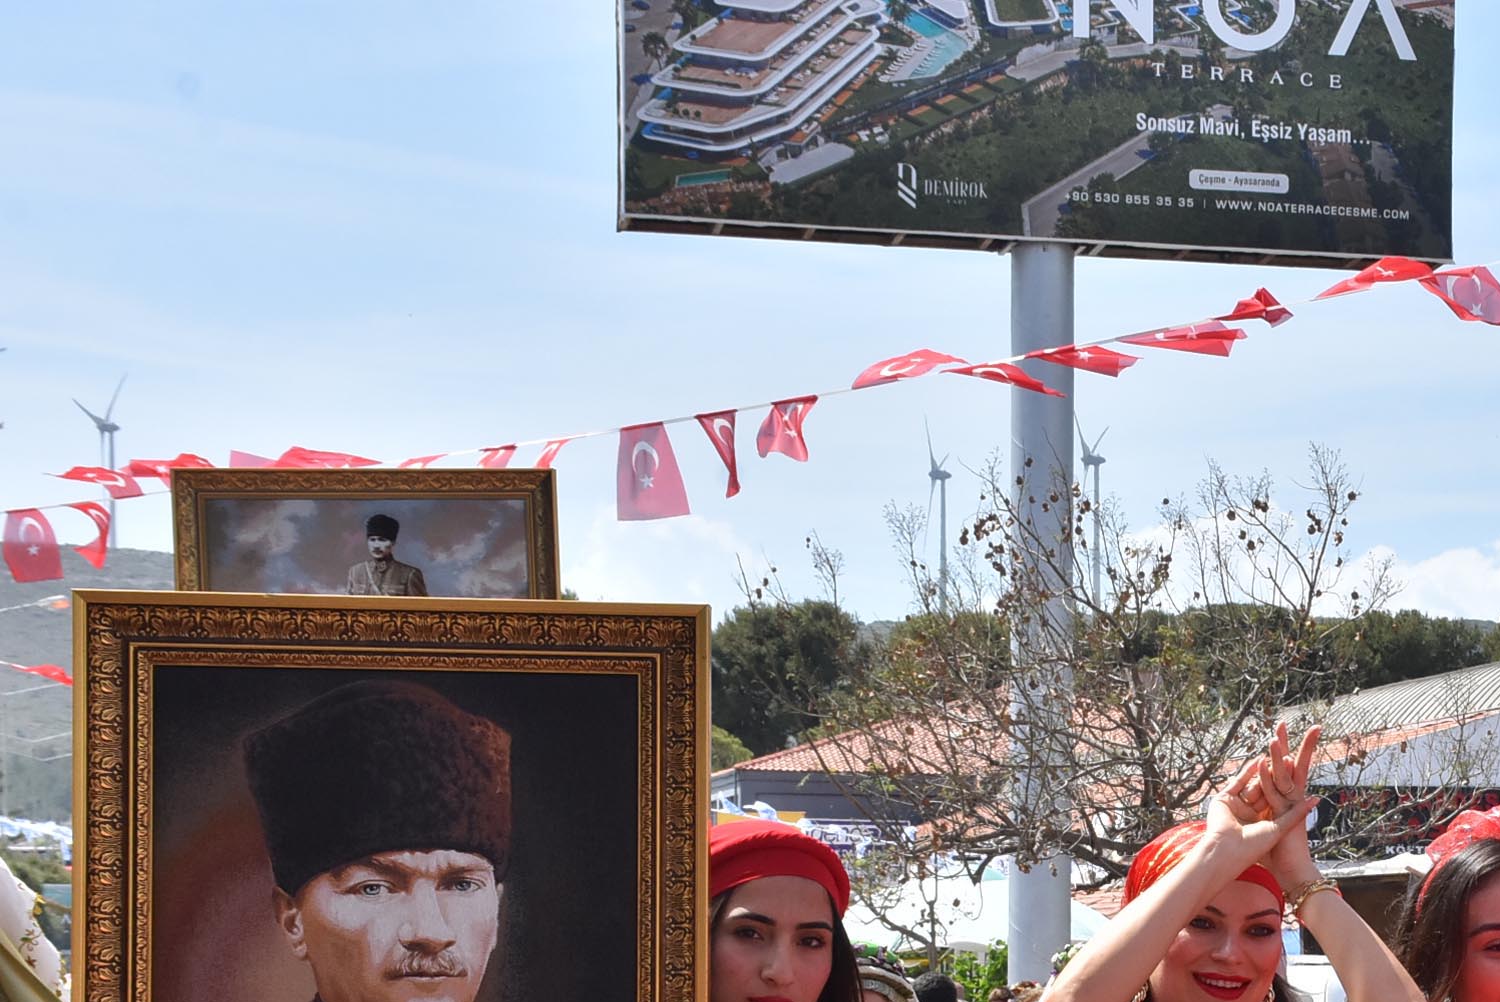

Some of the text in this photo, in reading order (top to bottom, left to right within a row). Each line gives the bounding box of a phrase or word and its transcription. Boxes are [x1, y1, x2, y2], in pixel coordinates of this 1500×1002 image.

[1151, 62, 1343, 90] TERRACE
[1136, 112, 1194, 134] Sonsuz
[1199, 117, 1245, 139] Mavi,
[1251, 120, 1292, 143] Eşsiz
[924, 177, 988, 199] DEMİROK
[1198, 173, 1226, 186] Çeşme
[1233, 175, 1280, 188] Ayasaranda
[1064, 191, 1410, 220] +90 530 855 35 35 WWW.NOATERRACECESME.COM
